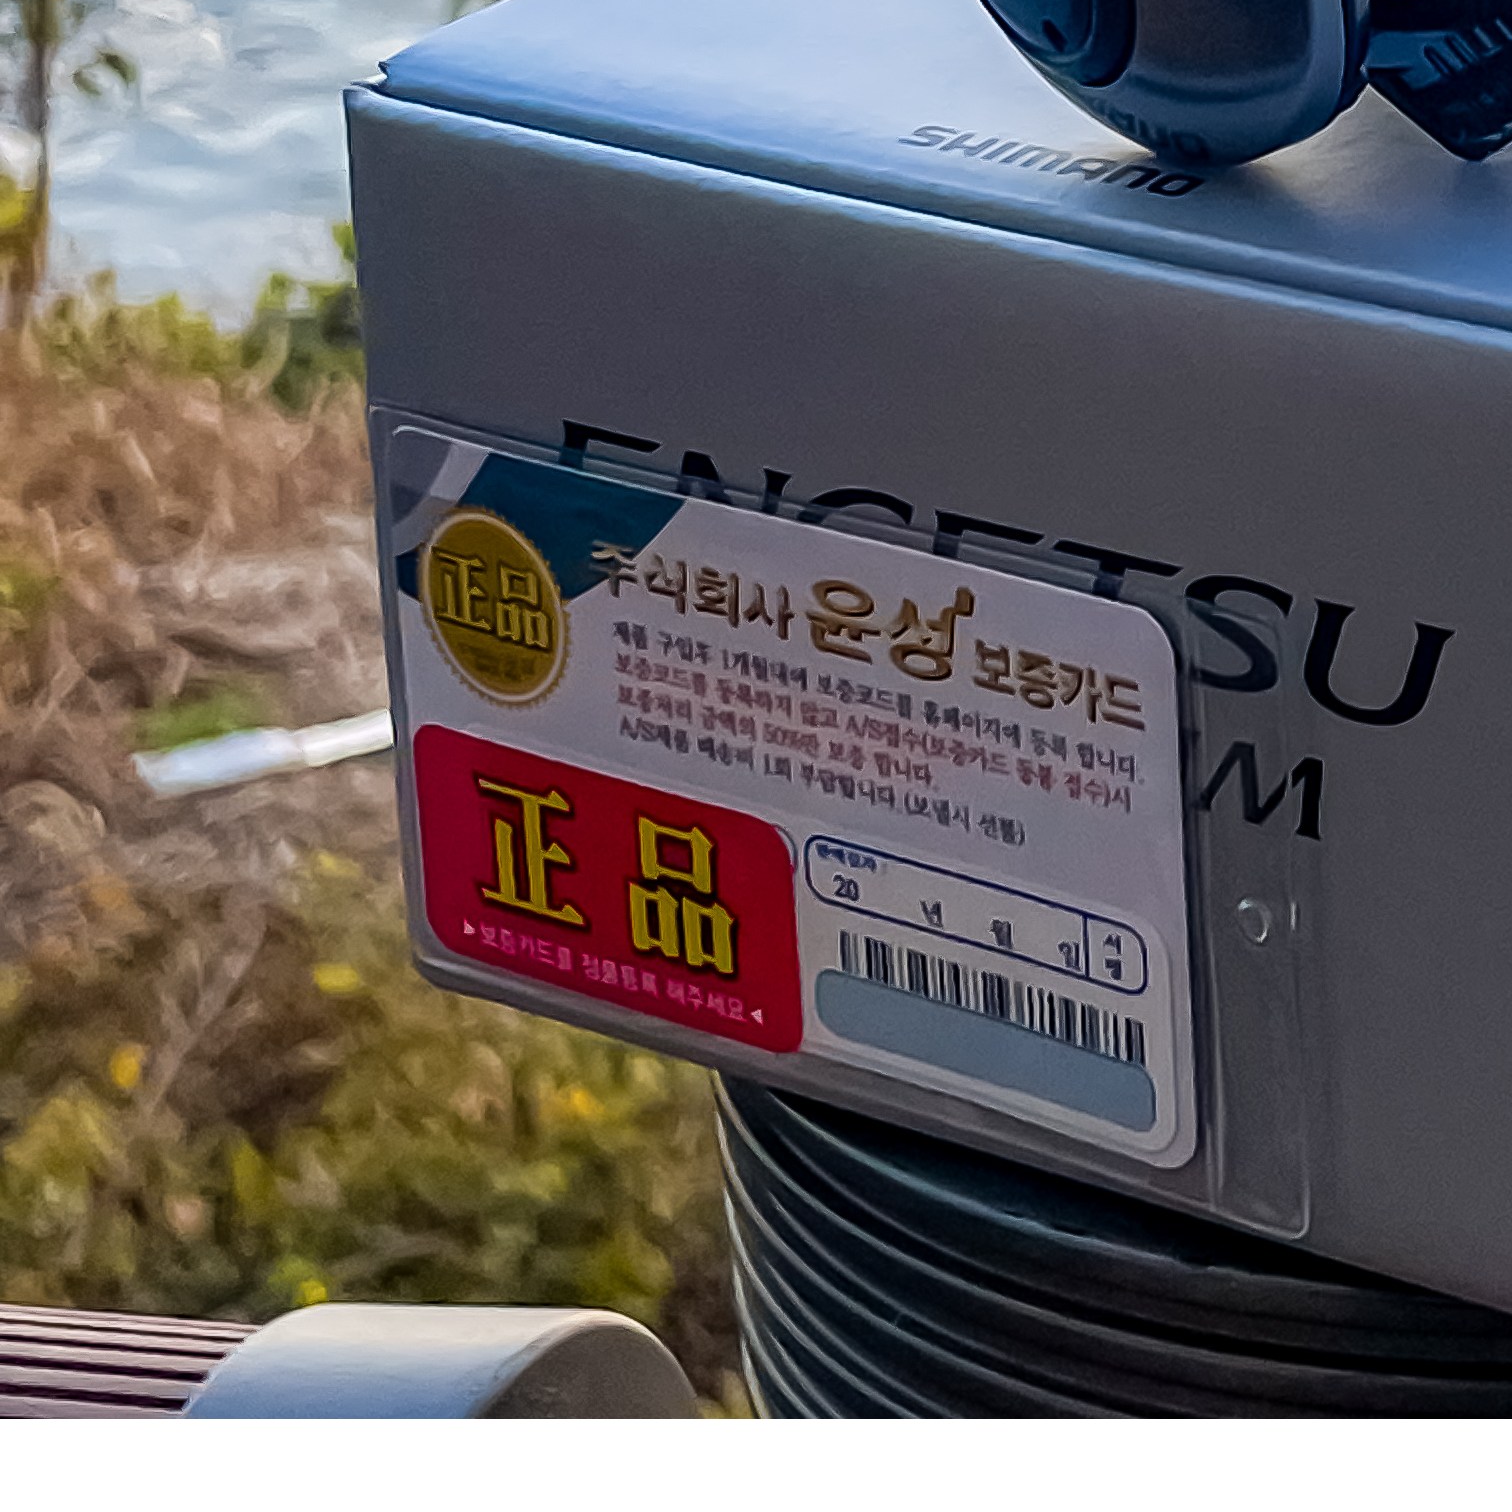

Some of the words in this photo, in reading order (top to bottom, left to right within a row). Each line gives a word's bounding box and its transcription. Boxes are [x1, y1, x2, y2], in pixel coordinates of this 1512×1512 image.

[900, 125, 1206, 198] SHIMANO
[431, 546, 550, 652] 正品
[590, 540, 795, 640] 주식회사
[806, 579, 975, 682] 윤성
[973, 639, 1145, 731] 보증카드
[477, 778, 740, 976] 正品
[833, 874, 860, 901] 20
